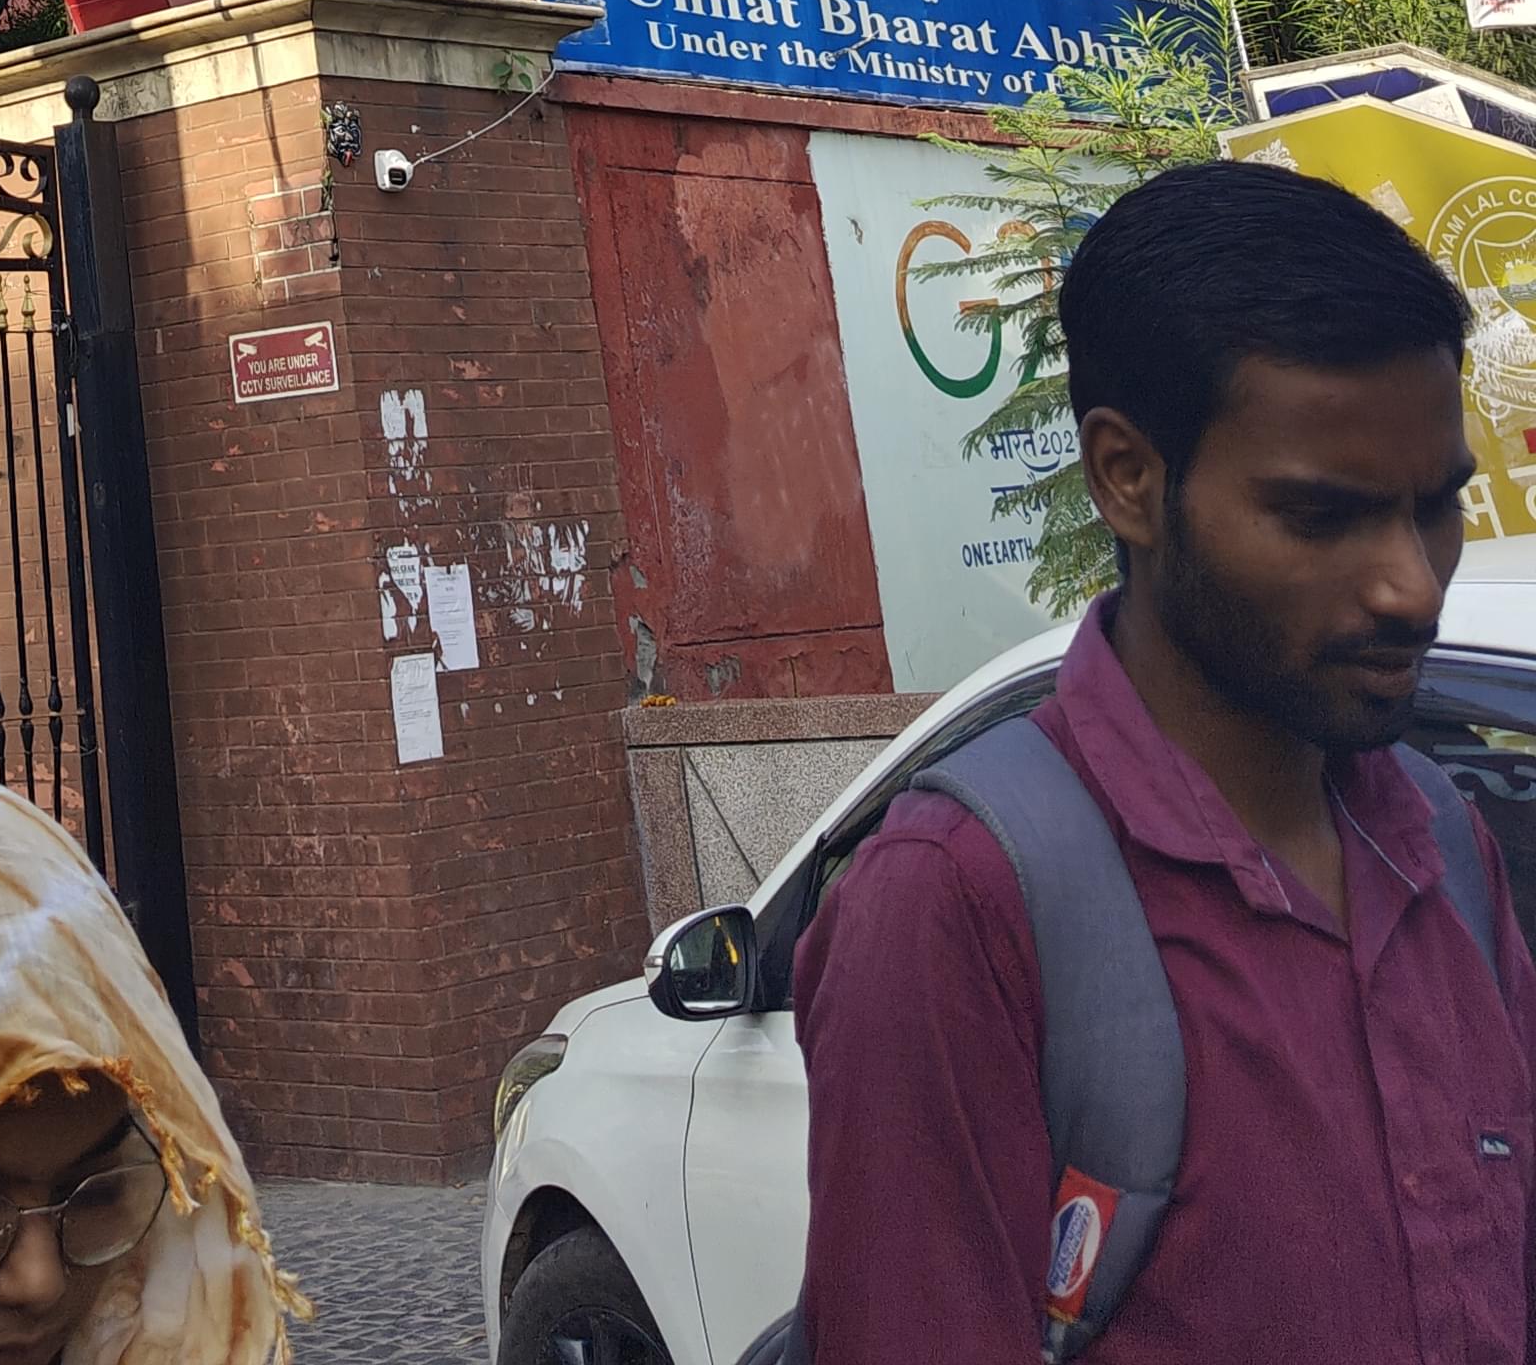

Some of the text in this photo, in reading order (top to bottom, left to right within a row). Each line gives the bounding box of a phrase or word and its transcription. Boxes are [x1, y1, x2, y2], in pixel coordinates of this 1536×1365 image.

[646, 20, 772, 61] Under
[780, 38, 836, 69] the
[848, 49, 993, 99] Ministry
[1003, 69, 1038, 99] of
[1463, 191, 1503, 219] LAL
[248, 353, 318, 375] YOU ARE UNDER
[241, 370, 331, 395] CCTV SURVEILLANCE
[1039, 430, 1080, 455] 202
[962, 537, 1034, 568] ONE EARTH
